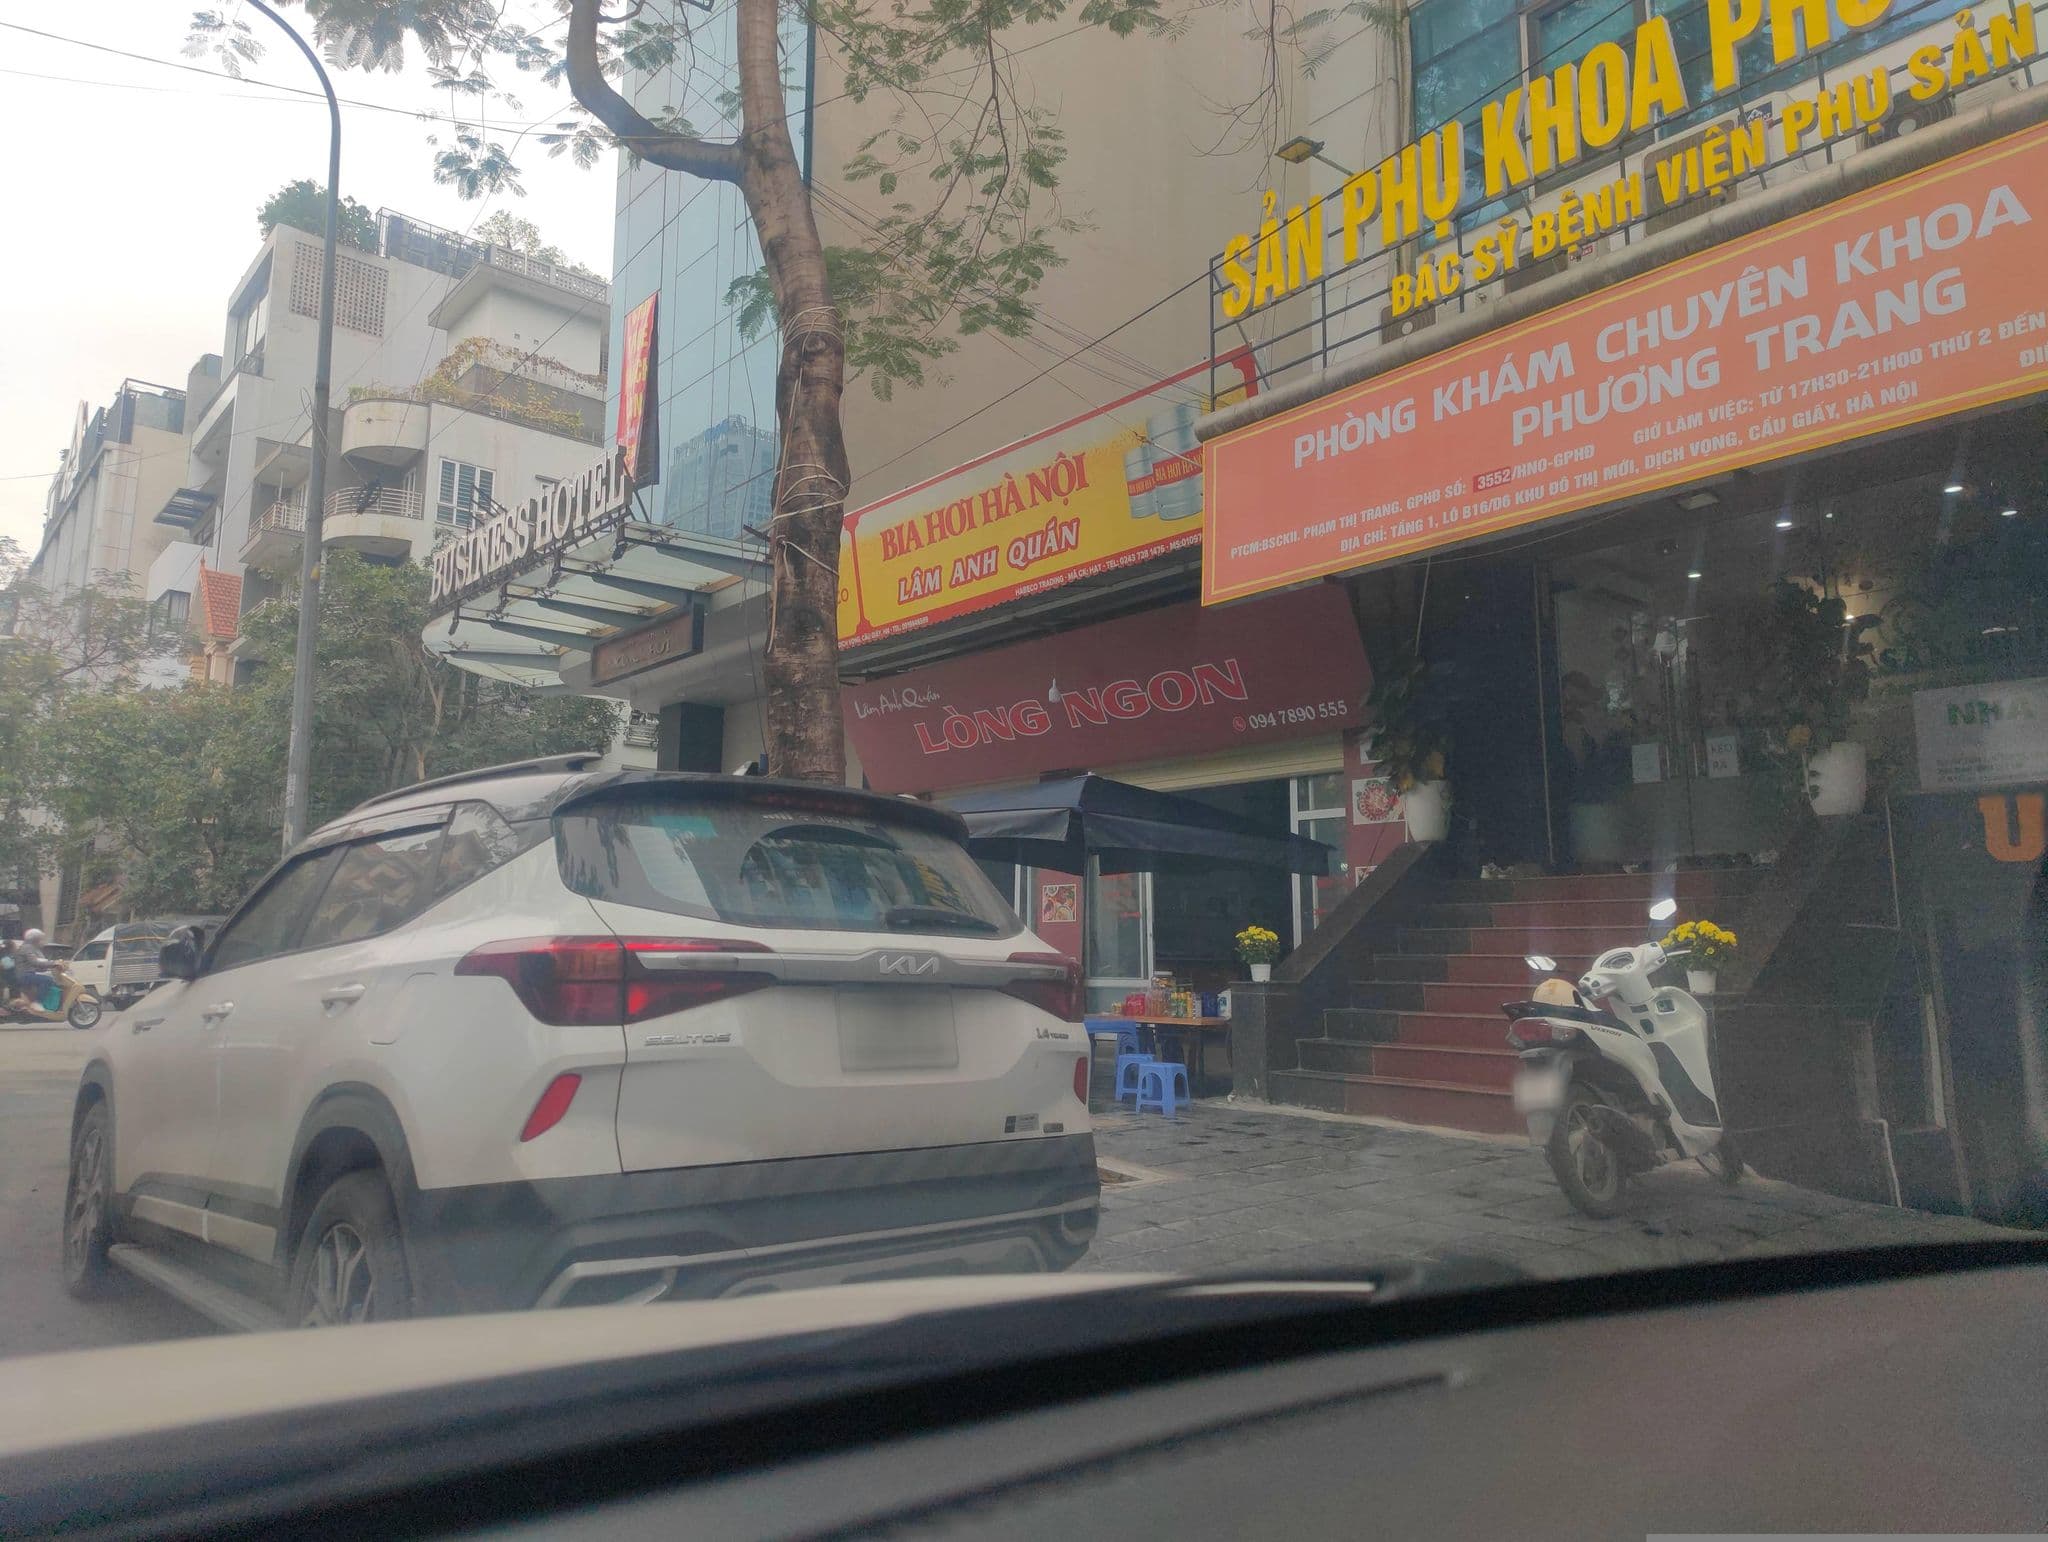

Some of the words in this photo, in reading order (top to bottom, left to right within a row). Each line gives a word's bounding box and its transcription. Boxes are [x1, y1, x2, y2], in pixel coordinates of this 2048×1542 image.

[1223, 187, 1326, 318] SẢN
[1343, 120, 1463, 265] PHỤ
[1482, 17, 1689, 197] KHOA
[1708, 0, 1892, 92] PH
[1392, 252, 1461, 317] BÁC
[1532, 172, 1644, 262] BỆNH
[1655, 119, 1767, 203] VIỆN
[1782, 66, 1890, 155] PHỤ
[1908, 2, 2037, 100] SẢN
[1294, 400, 1416, 469] PHÒNG
[1433, 341, 1576, 422] KHÁM
[1596, 256, 1809, 363] CHUYÊN
[1835, 183, 2032, 285] KHOA
[1513, 347, 1721, 447] PHƯƠNG
[1744, 266, 1967, 371] TRANG
[1666, 409, 1703, 435] LÀM
[1709, 398, 1755, 424] VIỆC:
[1759, 385, 1783, 409] TỪ
[1928, 330, 1974, 361] THỨ
[1978, 327, 1992, 346] 2
[1998, 309, 2047, 340] ĐẾN
[1514, 484, 1545, 506] KHU
[1644, 443, 1686, 471] DỊCH
[1748, 415, 1787, 443] CẦU
[1845, 387, 1876, 415] HÀ
[1879, 379, 1920, 408] NỘI
[430, 499, 531, 602] BUSINESS
[534, 445, 628, 551] HOTEL
[880, 522, 922, 562] BIA
[923, 496, 978, 545] HƠI
[978, 470, 1028, 525] HÀ
[1027, 450, 1090, 507] NỘI
[897, 564, 943, 605] LÂM
[949, 544, 1000, 588] ANH
[1006, 516, 1082, 571] QUÁN
[1303, 519, 1337, 540] PHẠM
[1339, 514, 1358, 530] THỊ
[913, 699, 1052, 755] LÒNG
[1057, 658, 1250, 729] NGON
[1318, 700, 1348, 718] 555
[645, 1032, 732, 1047] SELTOS
